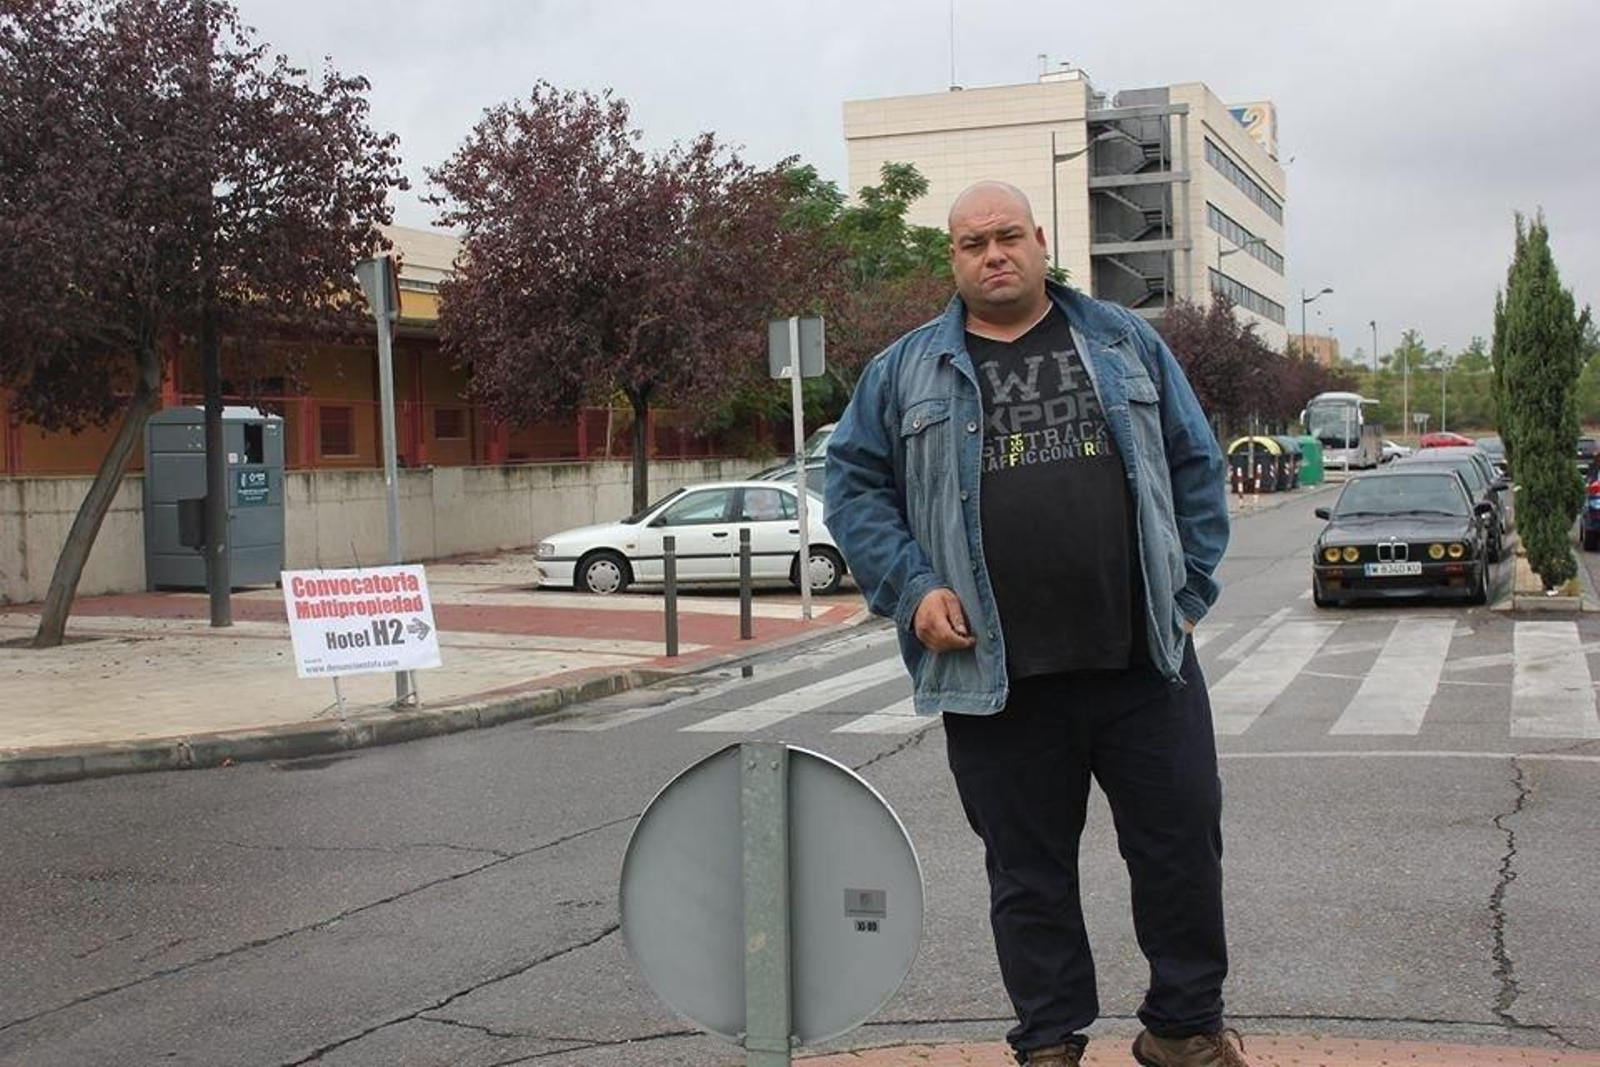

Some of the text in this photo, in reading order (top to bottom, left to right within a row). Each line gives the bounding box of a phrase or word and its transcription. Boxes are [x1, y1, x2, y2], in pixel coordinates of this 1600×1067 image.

[984, 450, 1037, 472] AFFIC
[1040, 440, 1111, 463] CONTROL
[291, 571, 420, 598] Convocatoria
[295, 595, 424, 620] Multipropiedad
[326, 618, 405, 650] Hotel H2
